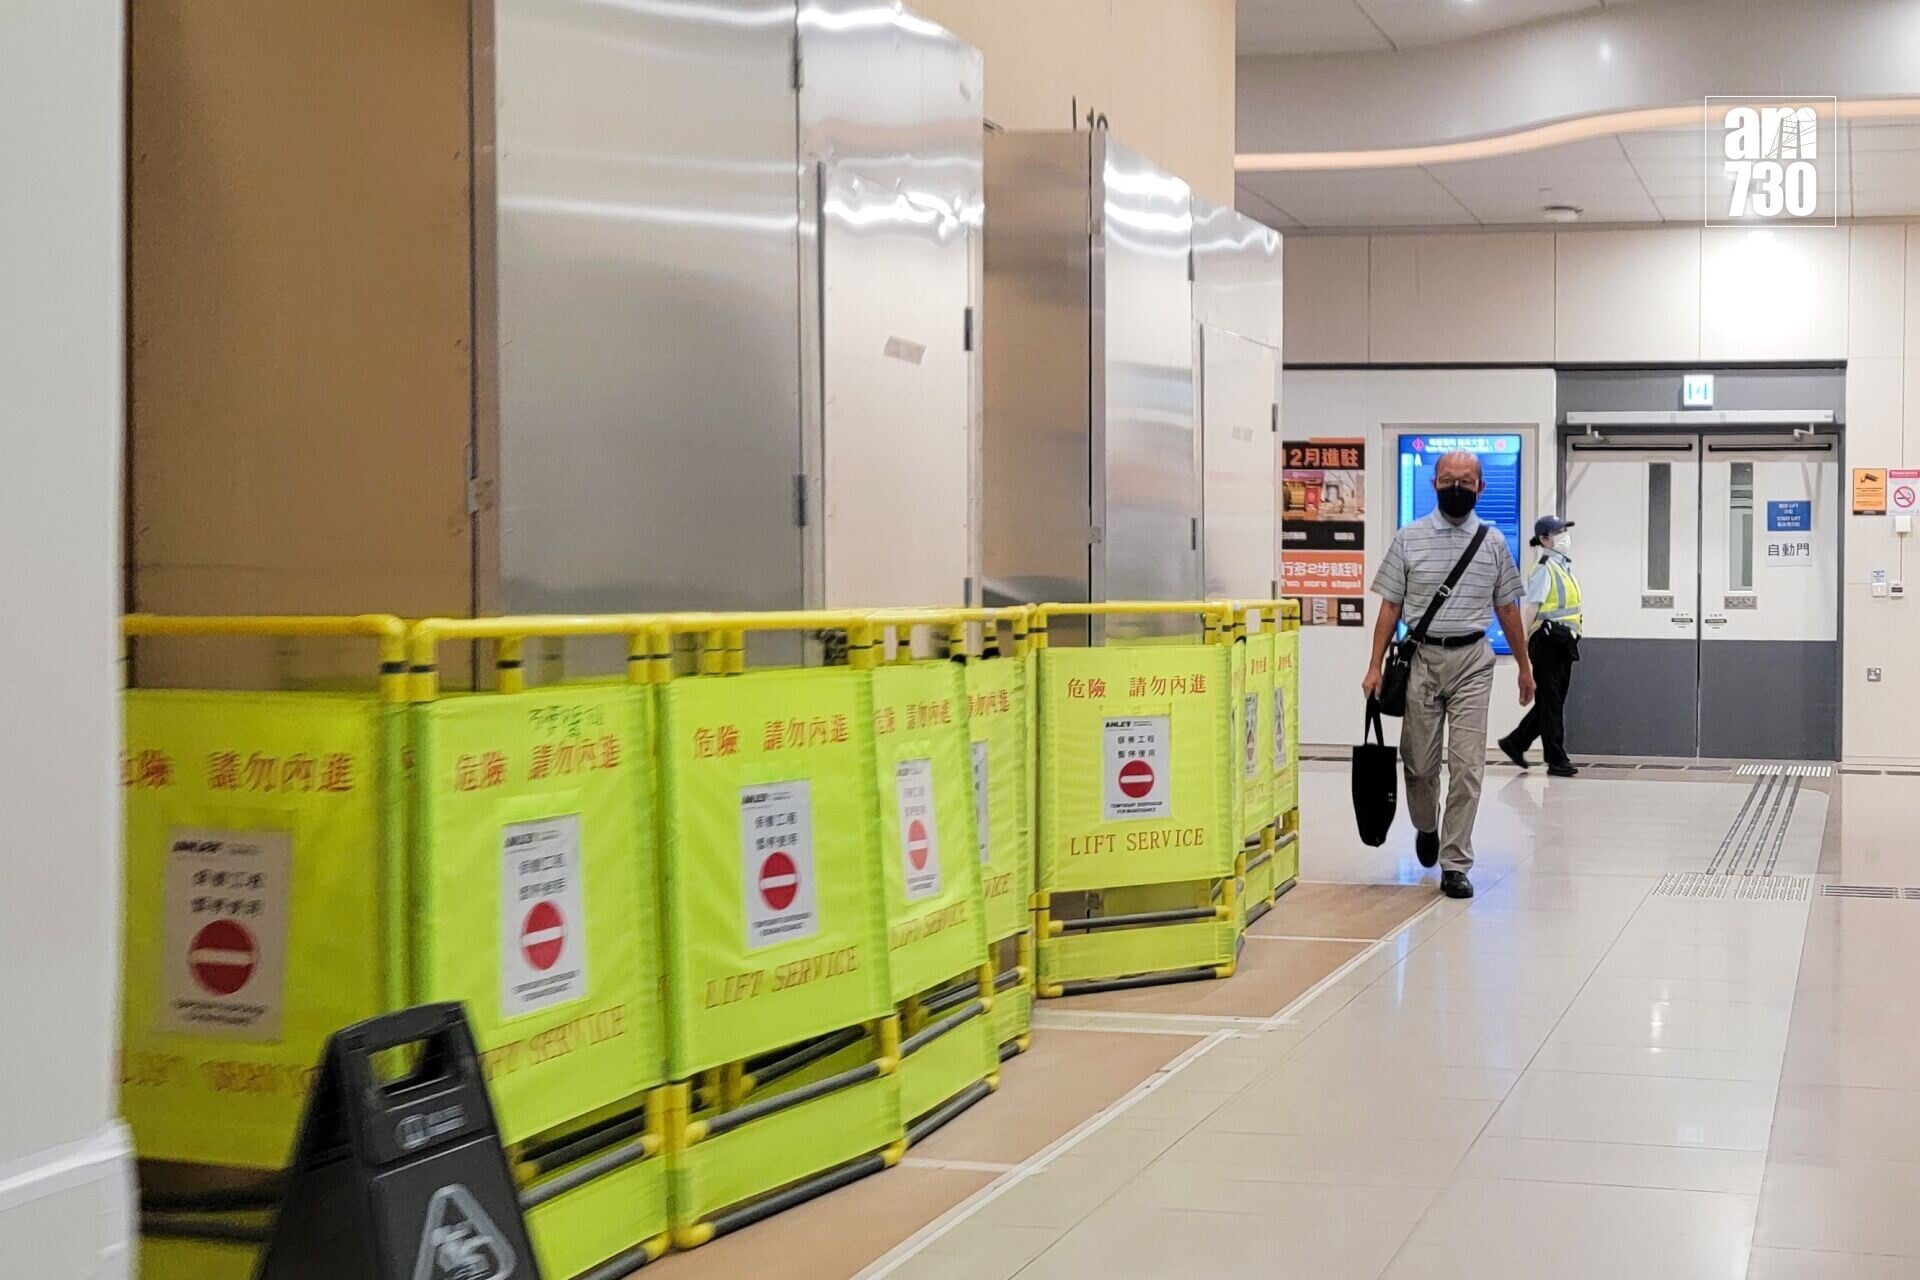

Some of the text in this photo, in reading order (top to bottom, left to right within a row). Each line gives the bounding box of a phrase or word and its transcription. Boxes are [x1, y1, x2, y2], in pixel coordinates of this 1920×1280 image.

[1768, 543, 1810, 556] 自動門
[1067, 678, 1107, 699] 危險
[693, 725, 740, 759] 危險
[1070, 829, 1204, 856] LIFT SERVICE
[705, 946, 858, 1010] LIFT SERVICE
